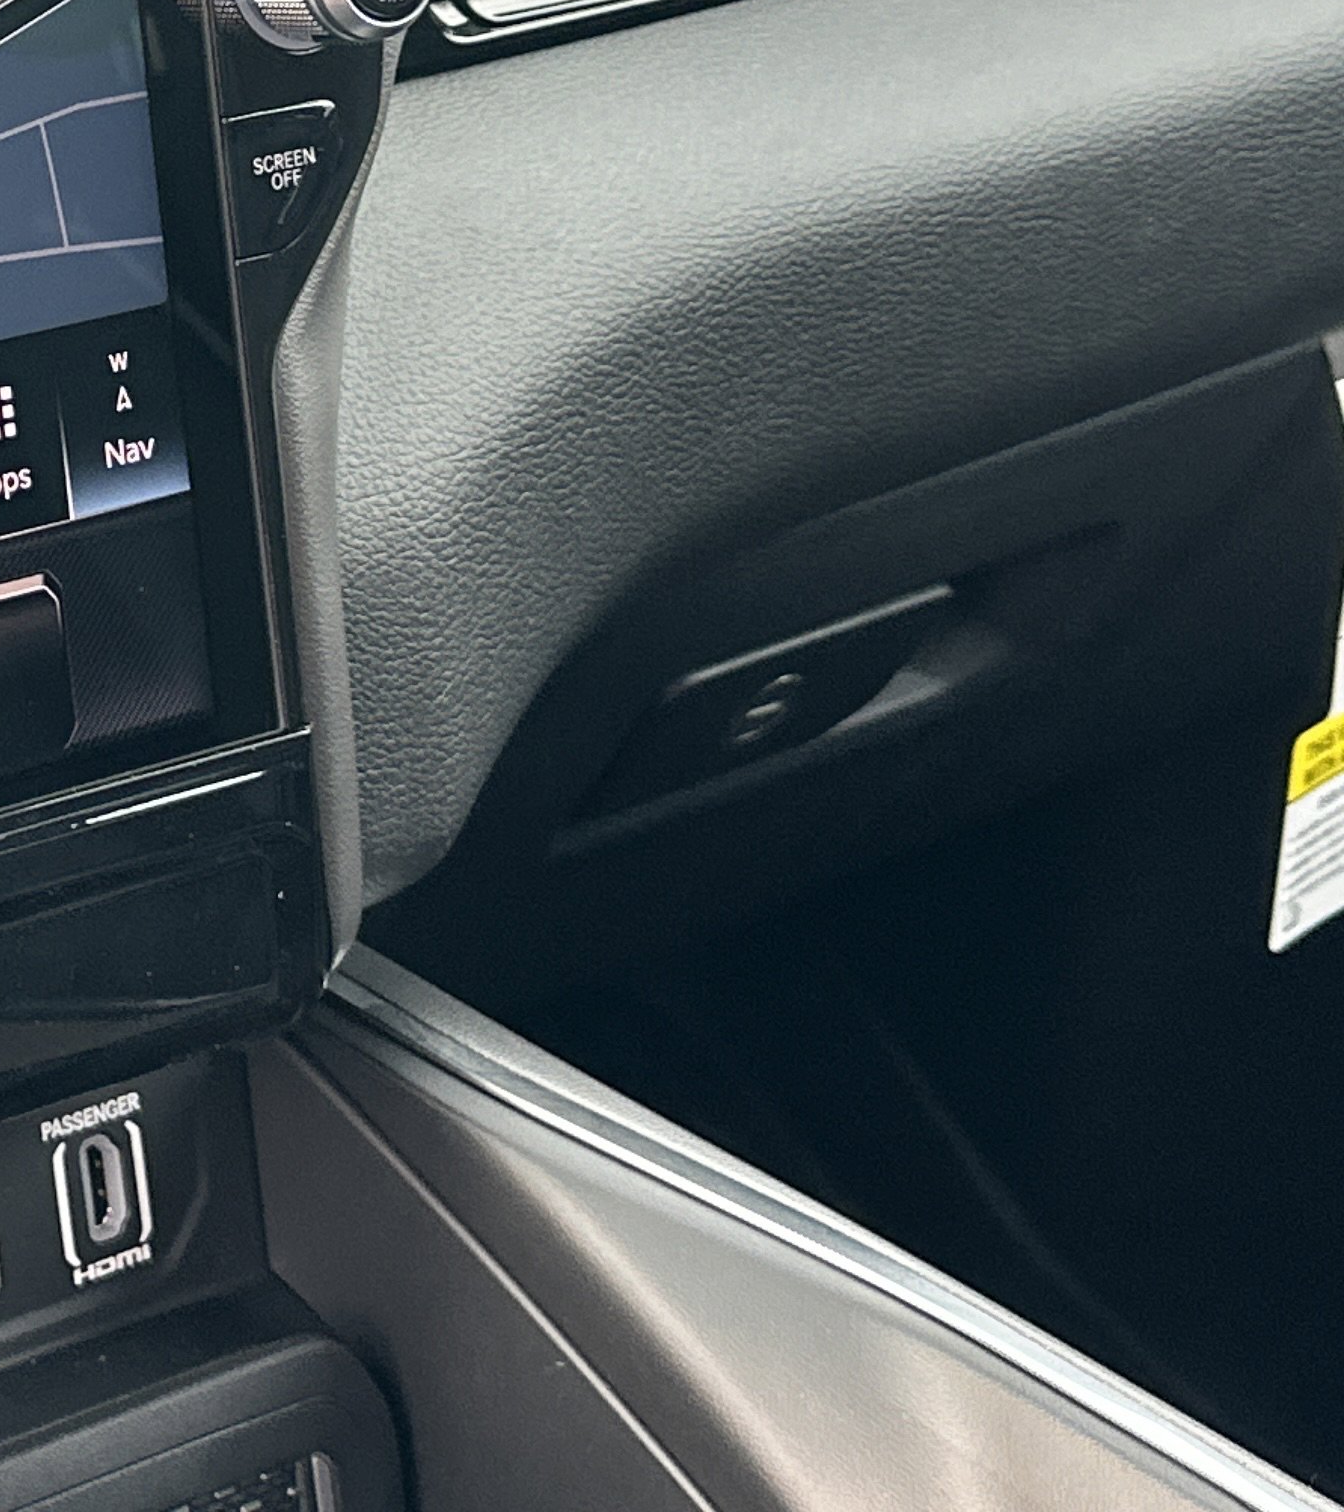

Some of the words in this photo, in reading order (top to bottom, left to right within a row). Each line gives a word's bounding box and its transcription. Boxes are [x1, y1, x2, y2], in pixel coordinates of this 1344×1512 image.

[252, 147, 316, 176] SCREEN
[271, 167, 302, 191] OFF
[108, 351, 128, 373] W
[104, 437, 155, 469] Nav
[40, 1091, 141, 1142] PASSENGER
